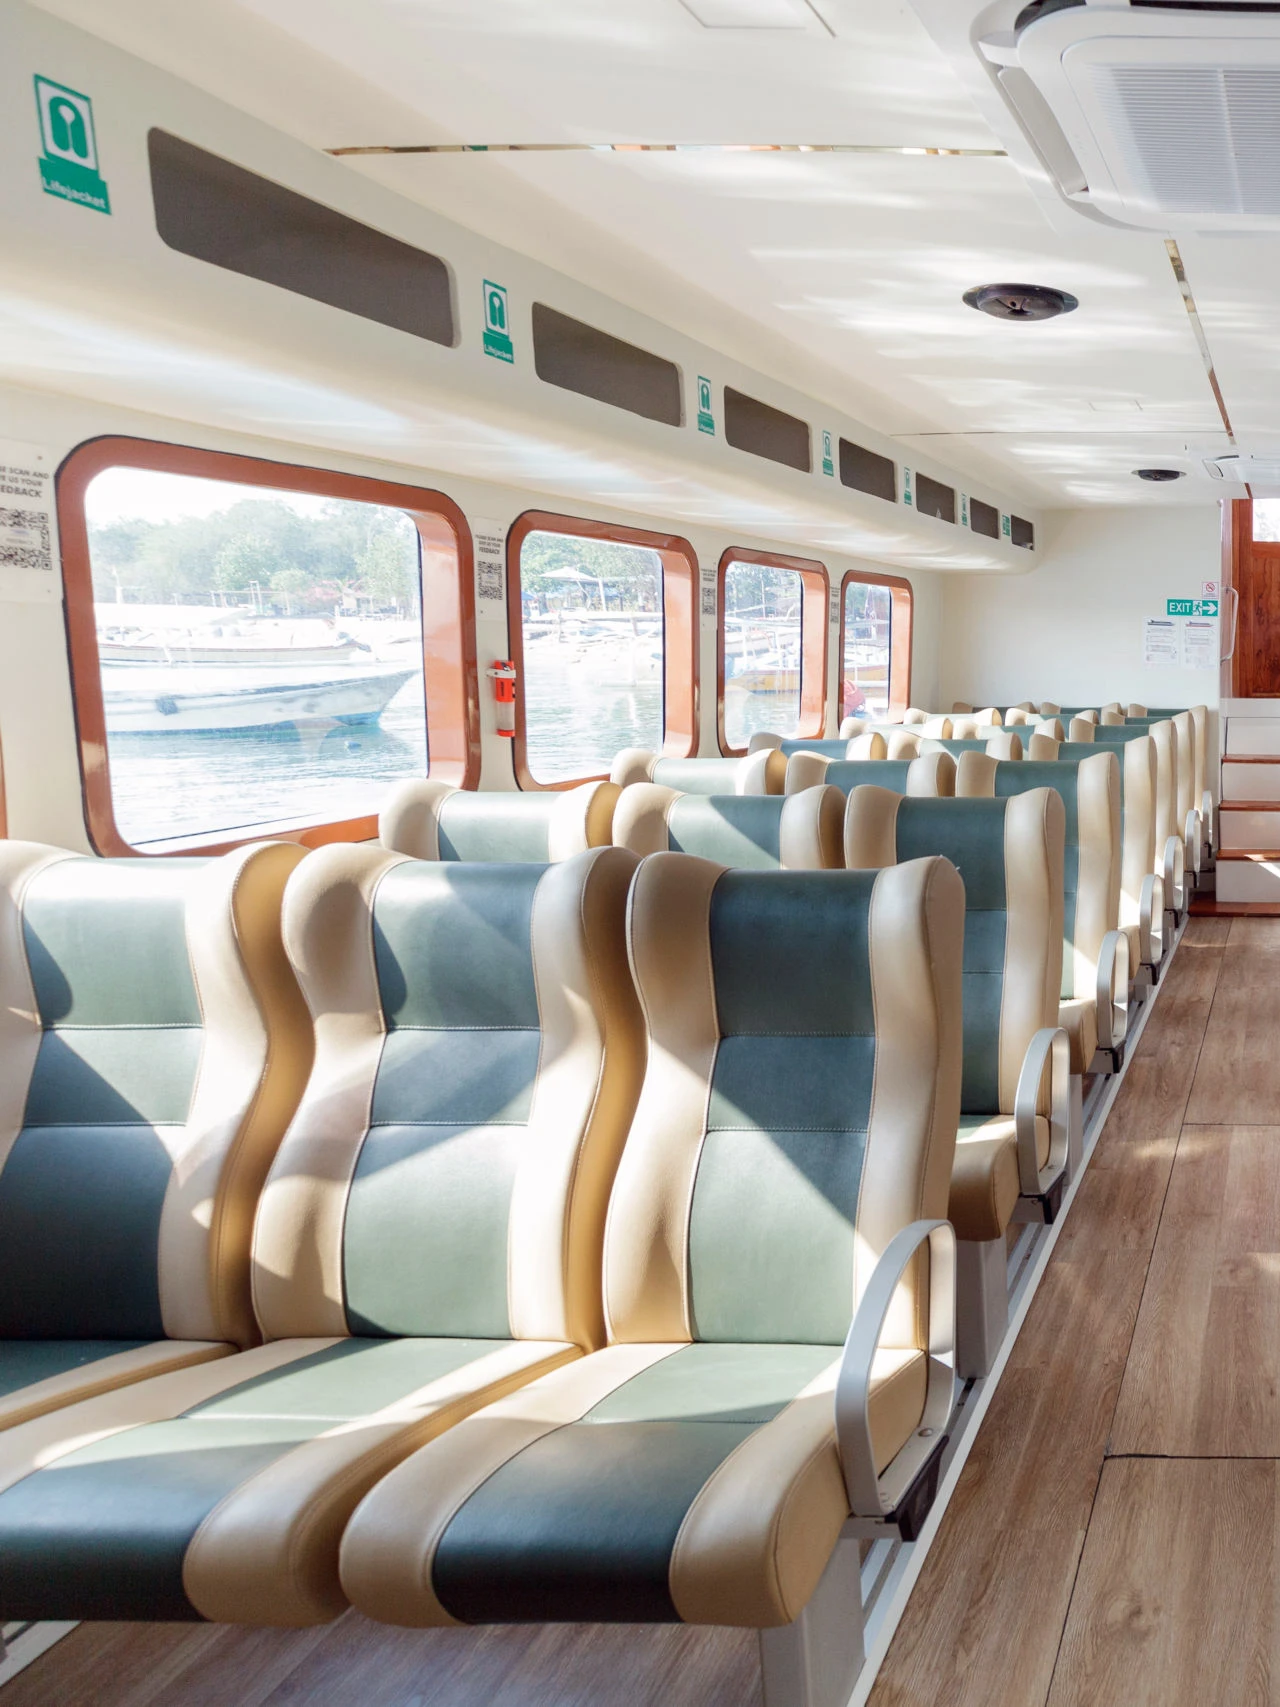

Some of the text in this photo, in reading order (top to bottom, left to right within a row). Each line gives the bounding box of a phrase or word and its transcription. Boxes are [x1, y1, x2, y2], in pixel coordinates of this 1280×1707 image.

[42, 176, 106, 209] Lifejacket
[32, 471, 50, 480] AND
[0, 485, 42, 498] EDBACK
[1169, 602, 1192, 613] EXIT
